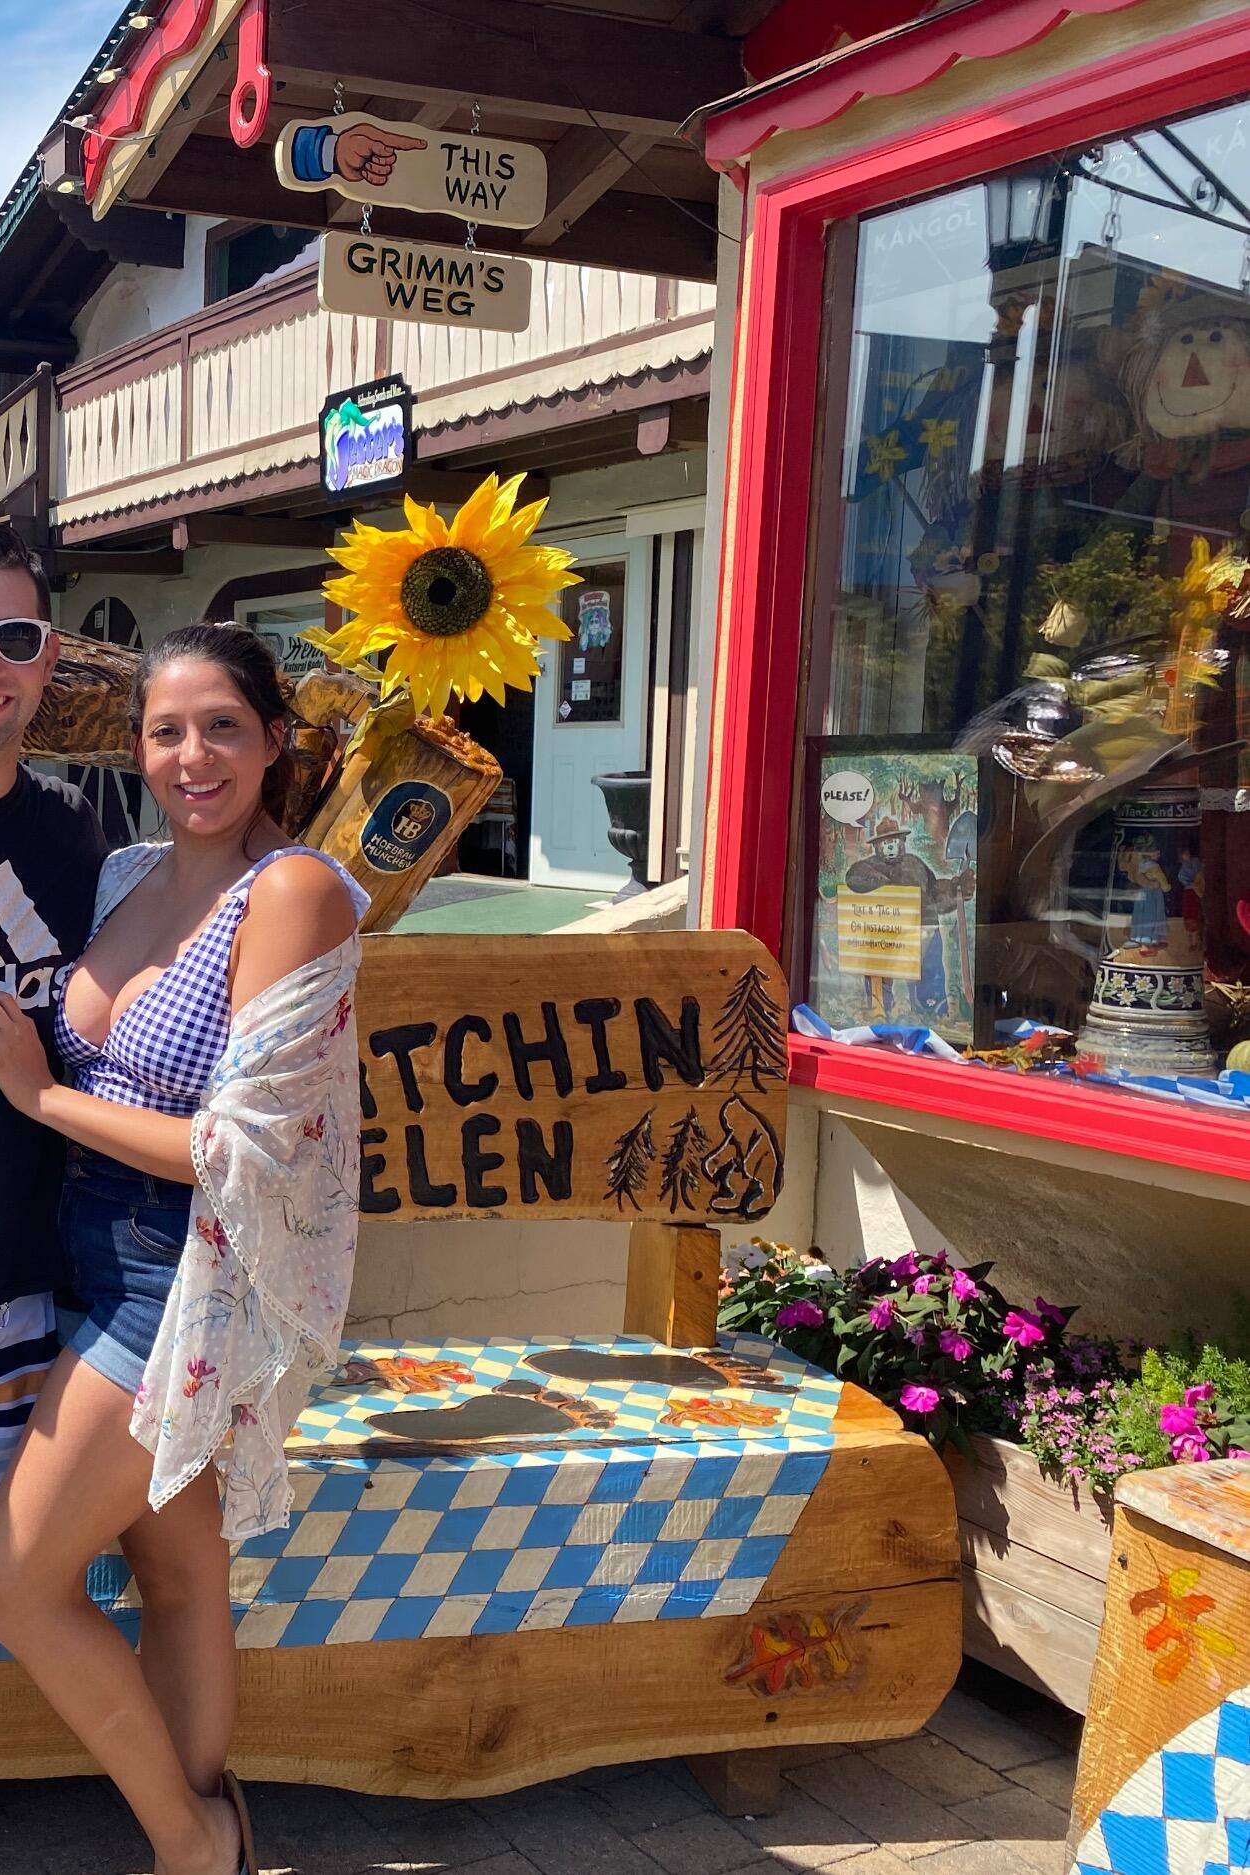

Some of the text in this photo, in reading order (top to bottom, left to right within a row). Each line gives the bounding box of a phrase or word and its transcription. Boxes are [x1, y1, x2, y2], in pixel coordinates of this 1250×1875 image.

[440, 142, 516, 180] THIS
[444, 175, 508, 211] WAY
[874, 209, 977, 254] KANGOL
[346, 241, 505, 293] GRIMM'S
[385, 280, 476, 317] WEG
[283, 661, 307, 673] Natural
[823, 788, 870, 802] PLEASE!
[1151, 805, 1174, 817] und
[394, 815, 422, 839] HB
